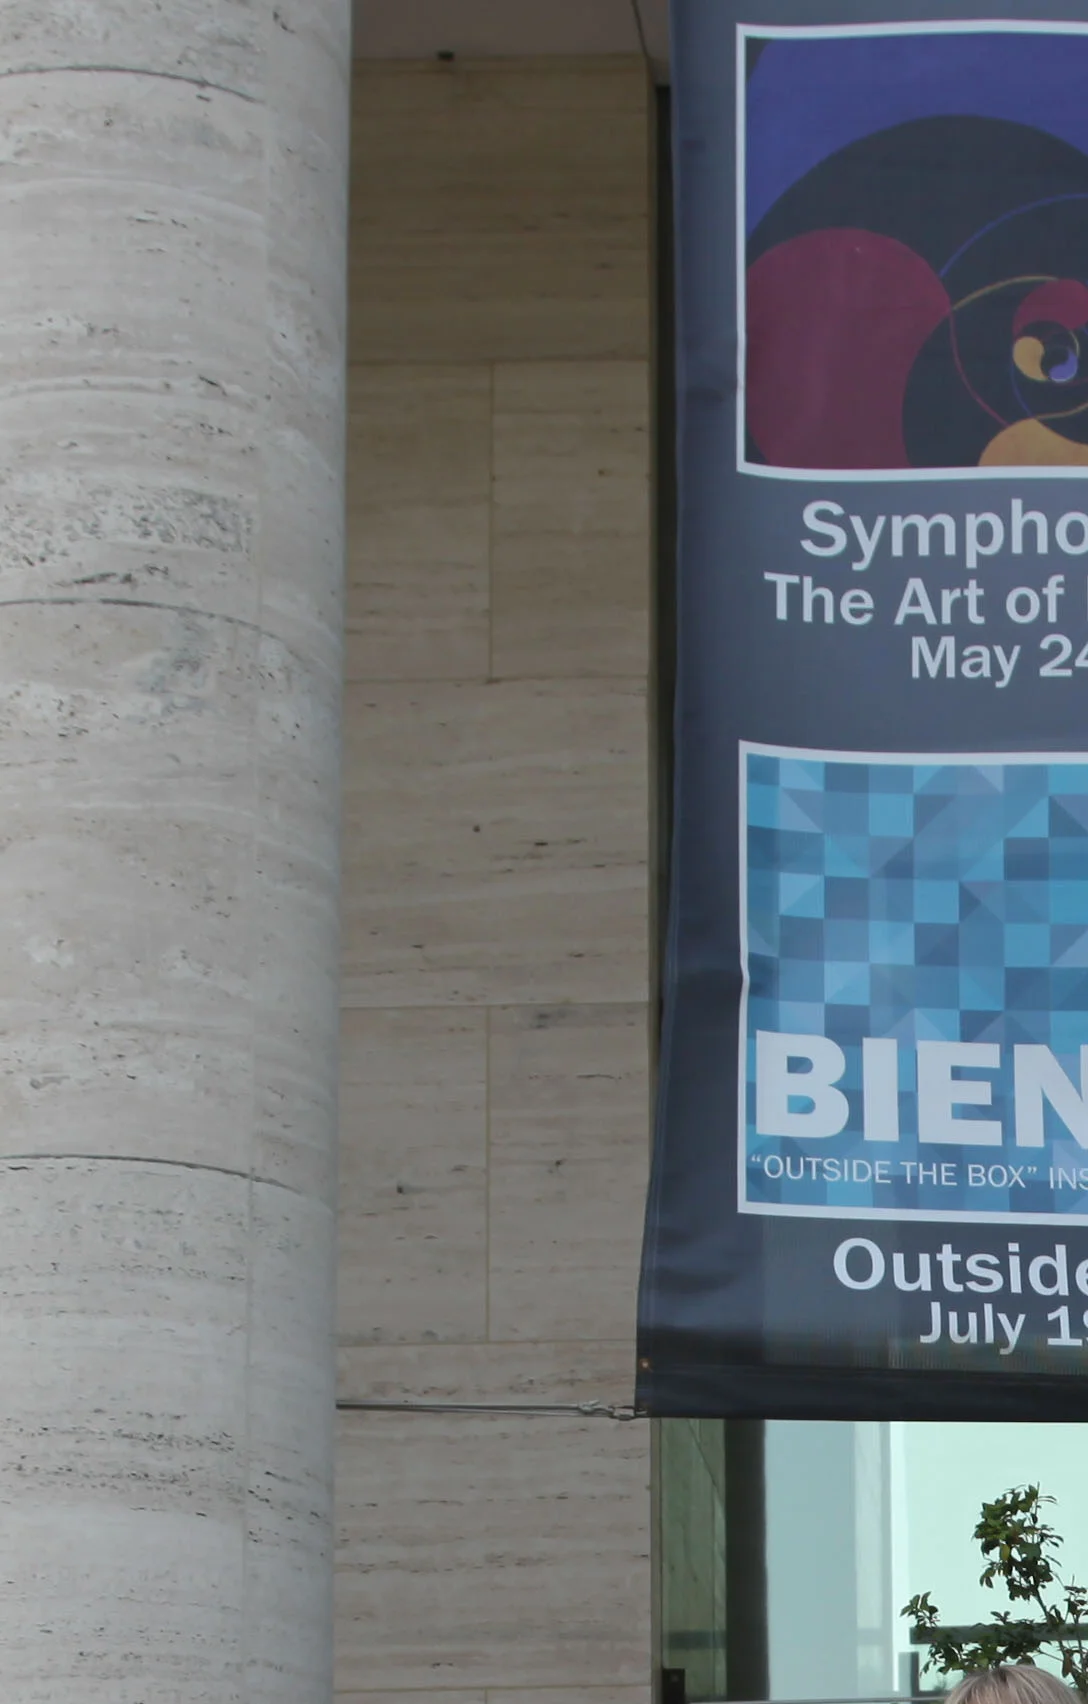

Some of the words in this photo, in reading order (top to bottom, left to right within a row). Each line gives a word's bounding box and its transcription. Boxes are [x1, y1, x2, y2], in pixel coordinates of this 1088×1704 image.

[764, 571, 874, 625] The
[894, 577, 985, 625] Art
[1005, 574, 1065, 624] of
[911, 635, 1021, 688] May
[750, 1153, 892, 1184] “OUTSIDE
[900, 1161, 957, 1186] THE
[967, 1164, 1038, 1189] BOX”
[919, 1301, 1027, 1356] July
